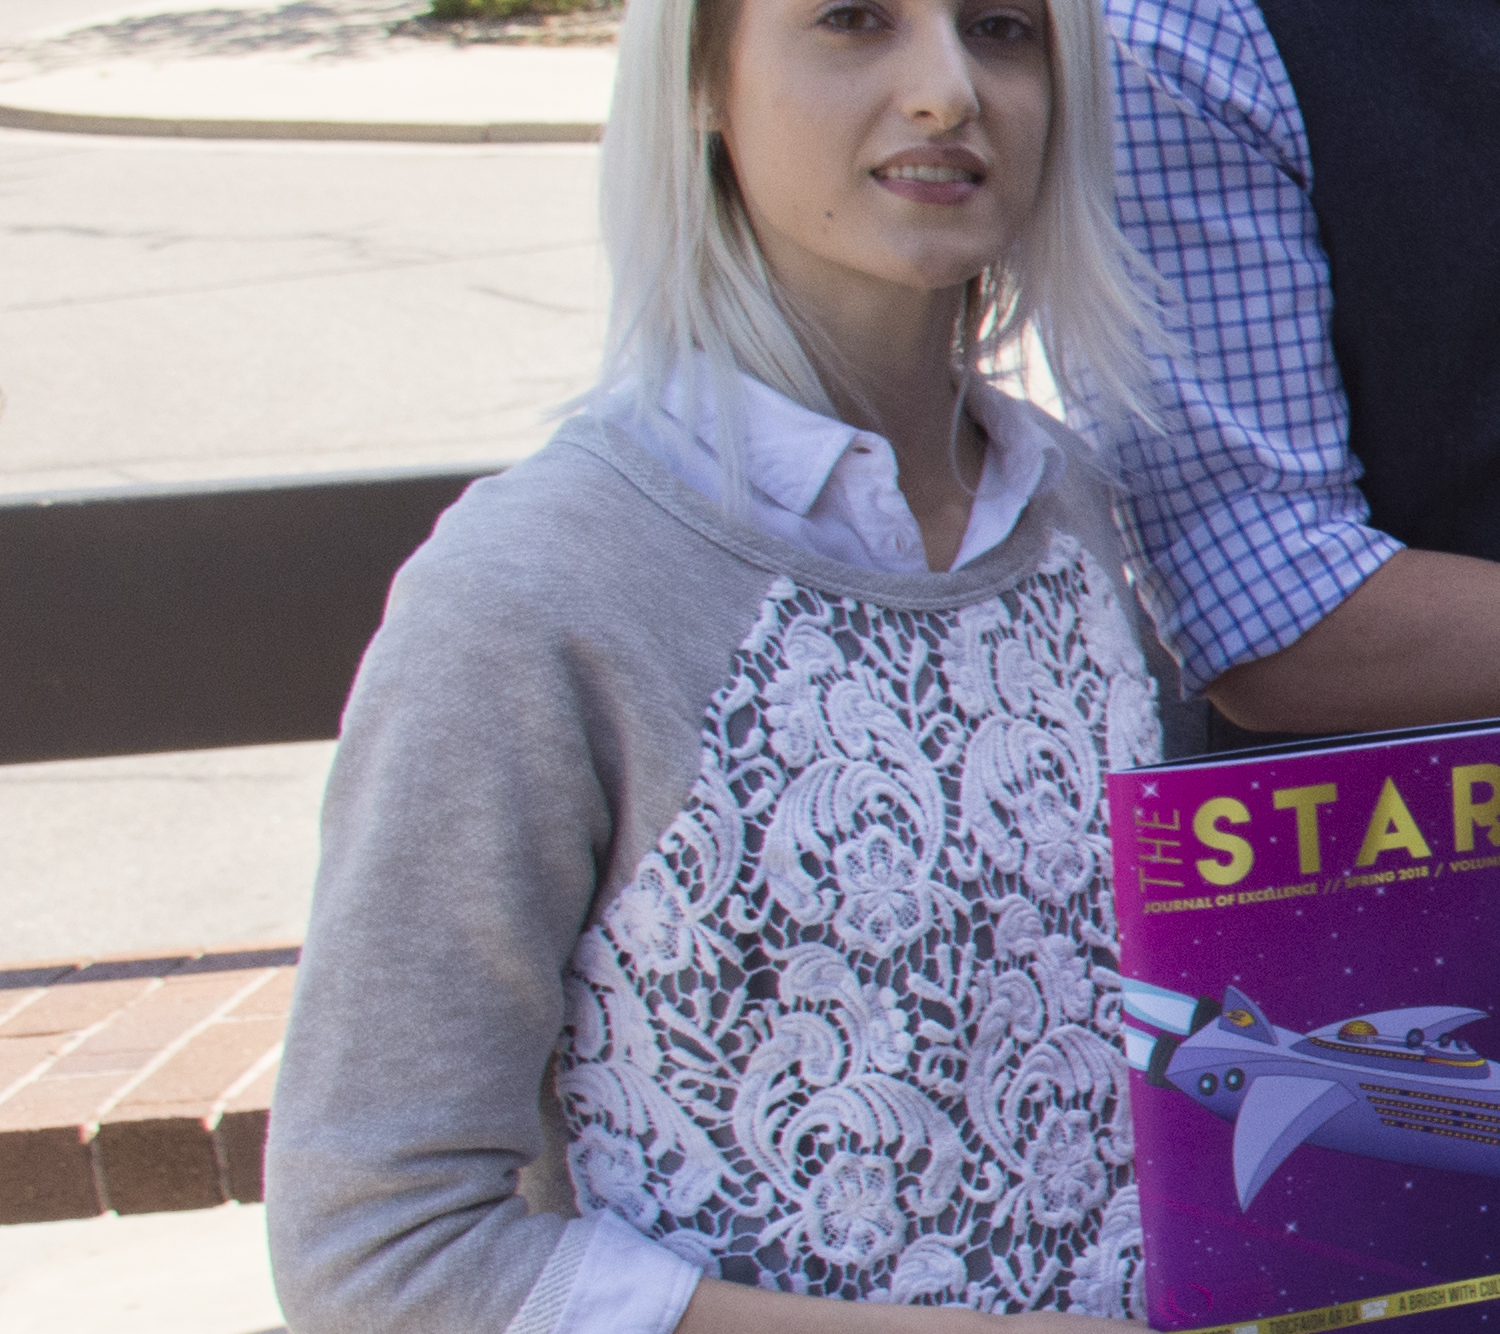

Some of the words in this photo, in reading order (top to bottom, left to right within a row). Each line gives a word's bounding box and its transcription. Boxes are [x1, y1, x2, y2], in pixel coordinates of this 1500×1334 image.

[1133, 805, 1185, 893] THE
[1143, 897, 1213, 914] JOURNAL
[1215, 894, 1235, 907] OF
[1238, 882, 1318, 905] EXCELLENCE
[1345, 870, 1396, 889] SPRING
[1398, 865, 1429, 880] 2018
[1408, 1289, 1445, 1310] BRUSH
[1447, 1284, 1477, 1303] WITH
